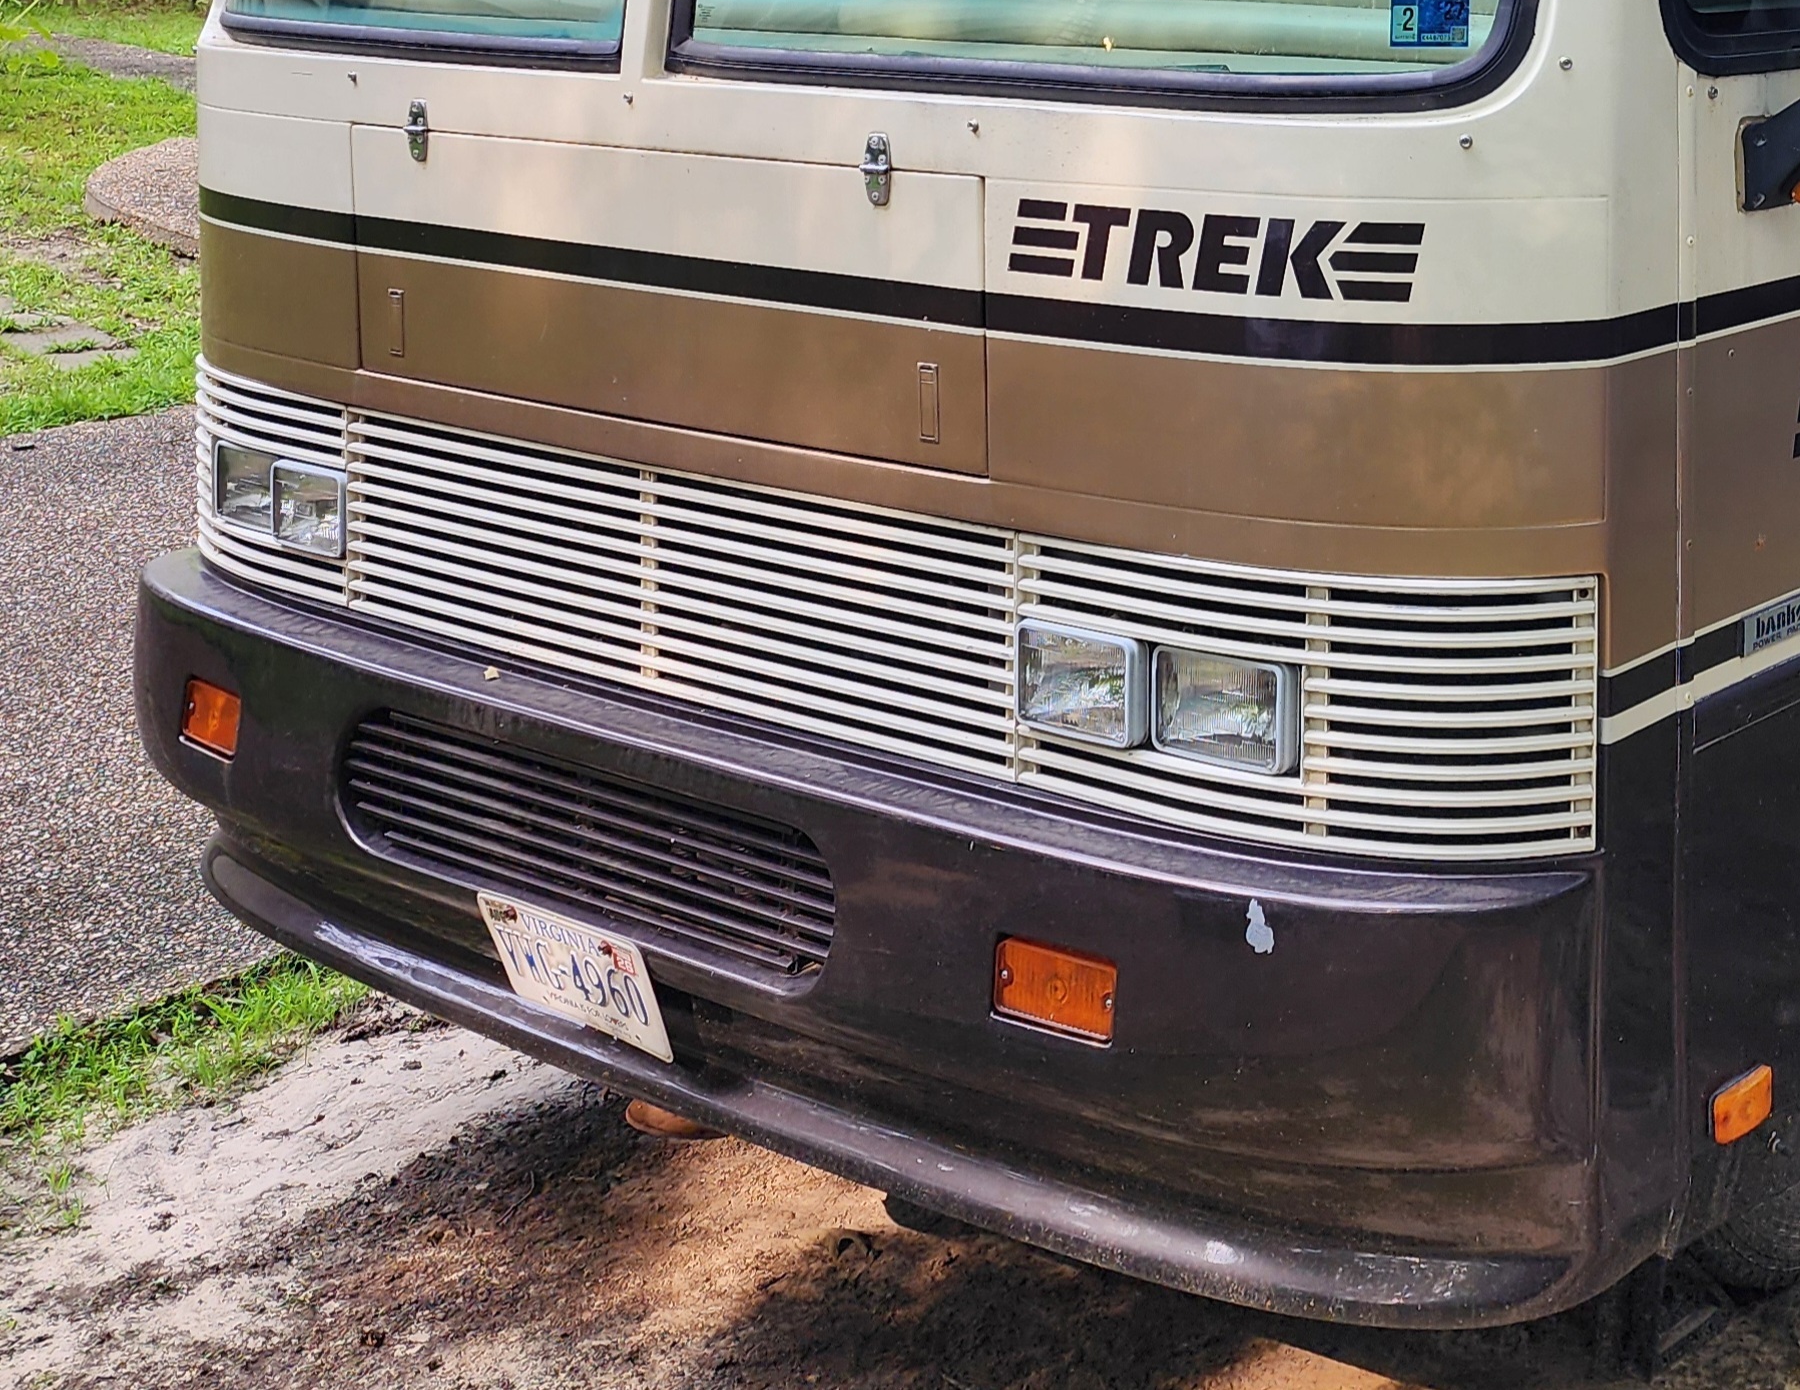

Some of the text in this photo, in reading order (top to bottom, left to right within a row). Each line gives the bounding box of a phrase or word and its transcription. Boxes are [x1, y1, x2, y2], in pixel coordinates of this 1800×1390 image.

[1402, 7, 1414, 31] 2
[1072, 203, 1347, 301] TREK
[1753, 631, 1782, 650] POWER
[520, 913, 600, 957] VIRGINIA
